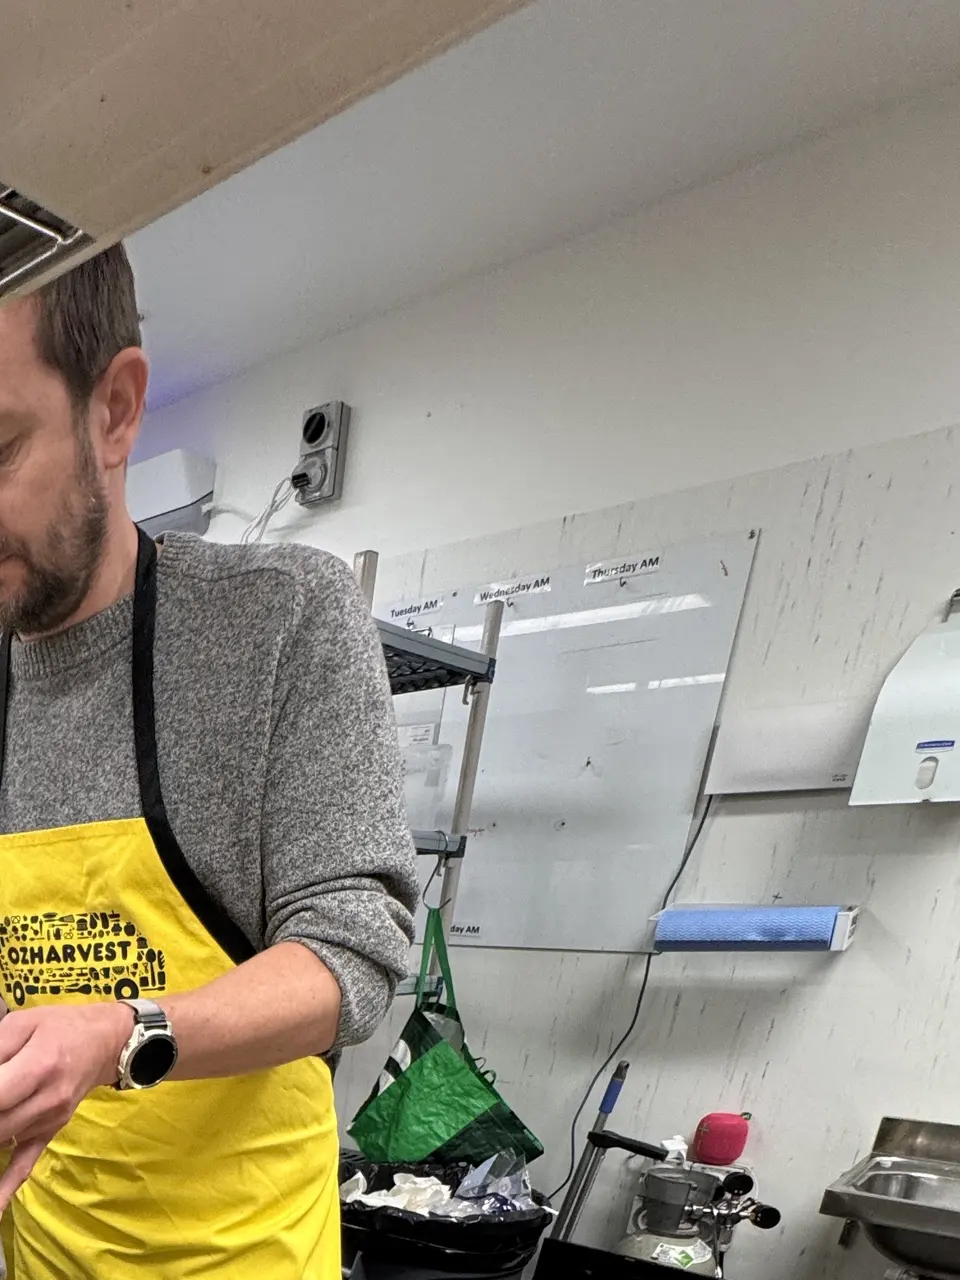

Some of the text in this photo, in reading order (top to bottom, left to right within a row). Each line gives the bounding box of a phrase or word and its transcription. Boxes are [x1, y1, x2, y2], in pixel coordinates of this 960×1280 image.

[592, 556, 660, 579] Thursday AM
[480, 576, 550, 601] Wednesday AM
[390, 599, 438, 618] Tuesday AM
[466, 926, 480, 934] AM
[8, 941, 131, 965] OZHARVEST
